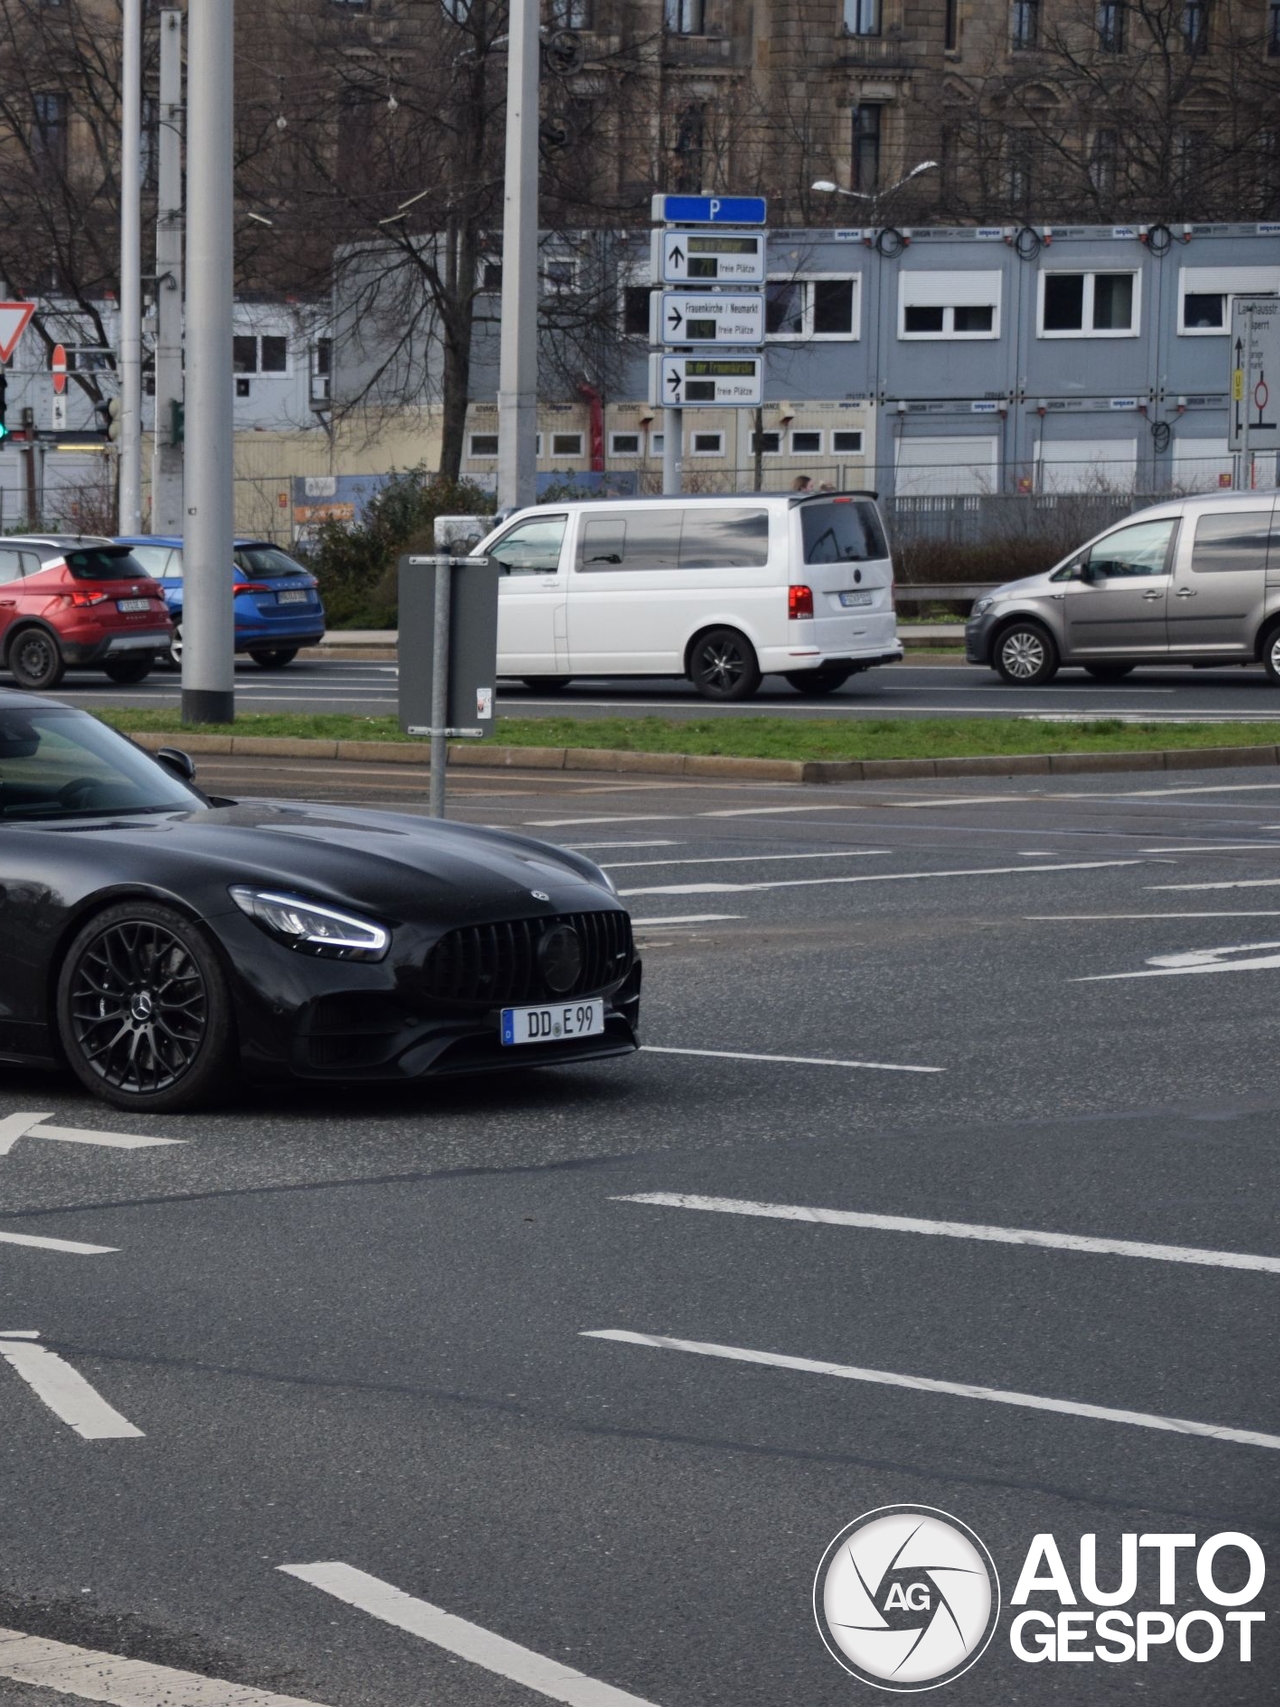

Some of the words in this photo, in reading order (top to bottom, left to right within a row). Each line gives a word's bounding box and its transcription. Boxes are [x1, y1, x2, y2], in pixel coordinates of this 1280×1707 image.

[710, 199, 720, 220] P
[720, 264, 734, 273] freie
[736, 264, 755, 273] Plätze
[686, 303, 722, 313] Frauenkirche
[730, 303, 758, 314] Neumarkt
[718, 326, 732, 334] freie
[735, 326, 754, 335] Plätze
[717, 387, 731, 396] freie
[734, 387, 753, 396] Plätze
[527, 1010, 551, 1038] DD
[563, 1008, 573, 1034] E
[577, 1005, 593, 1032] 99
